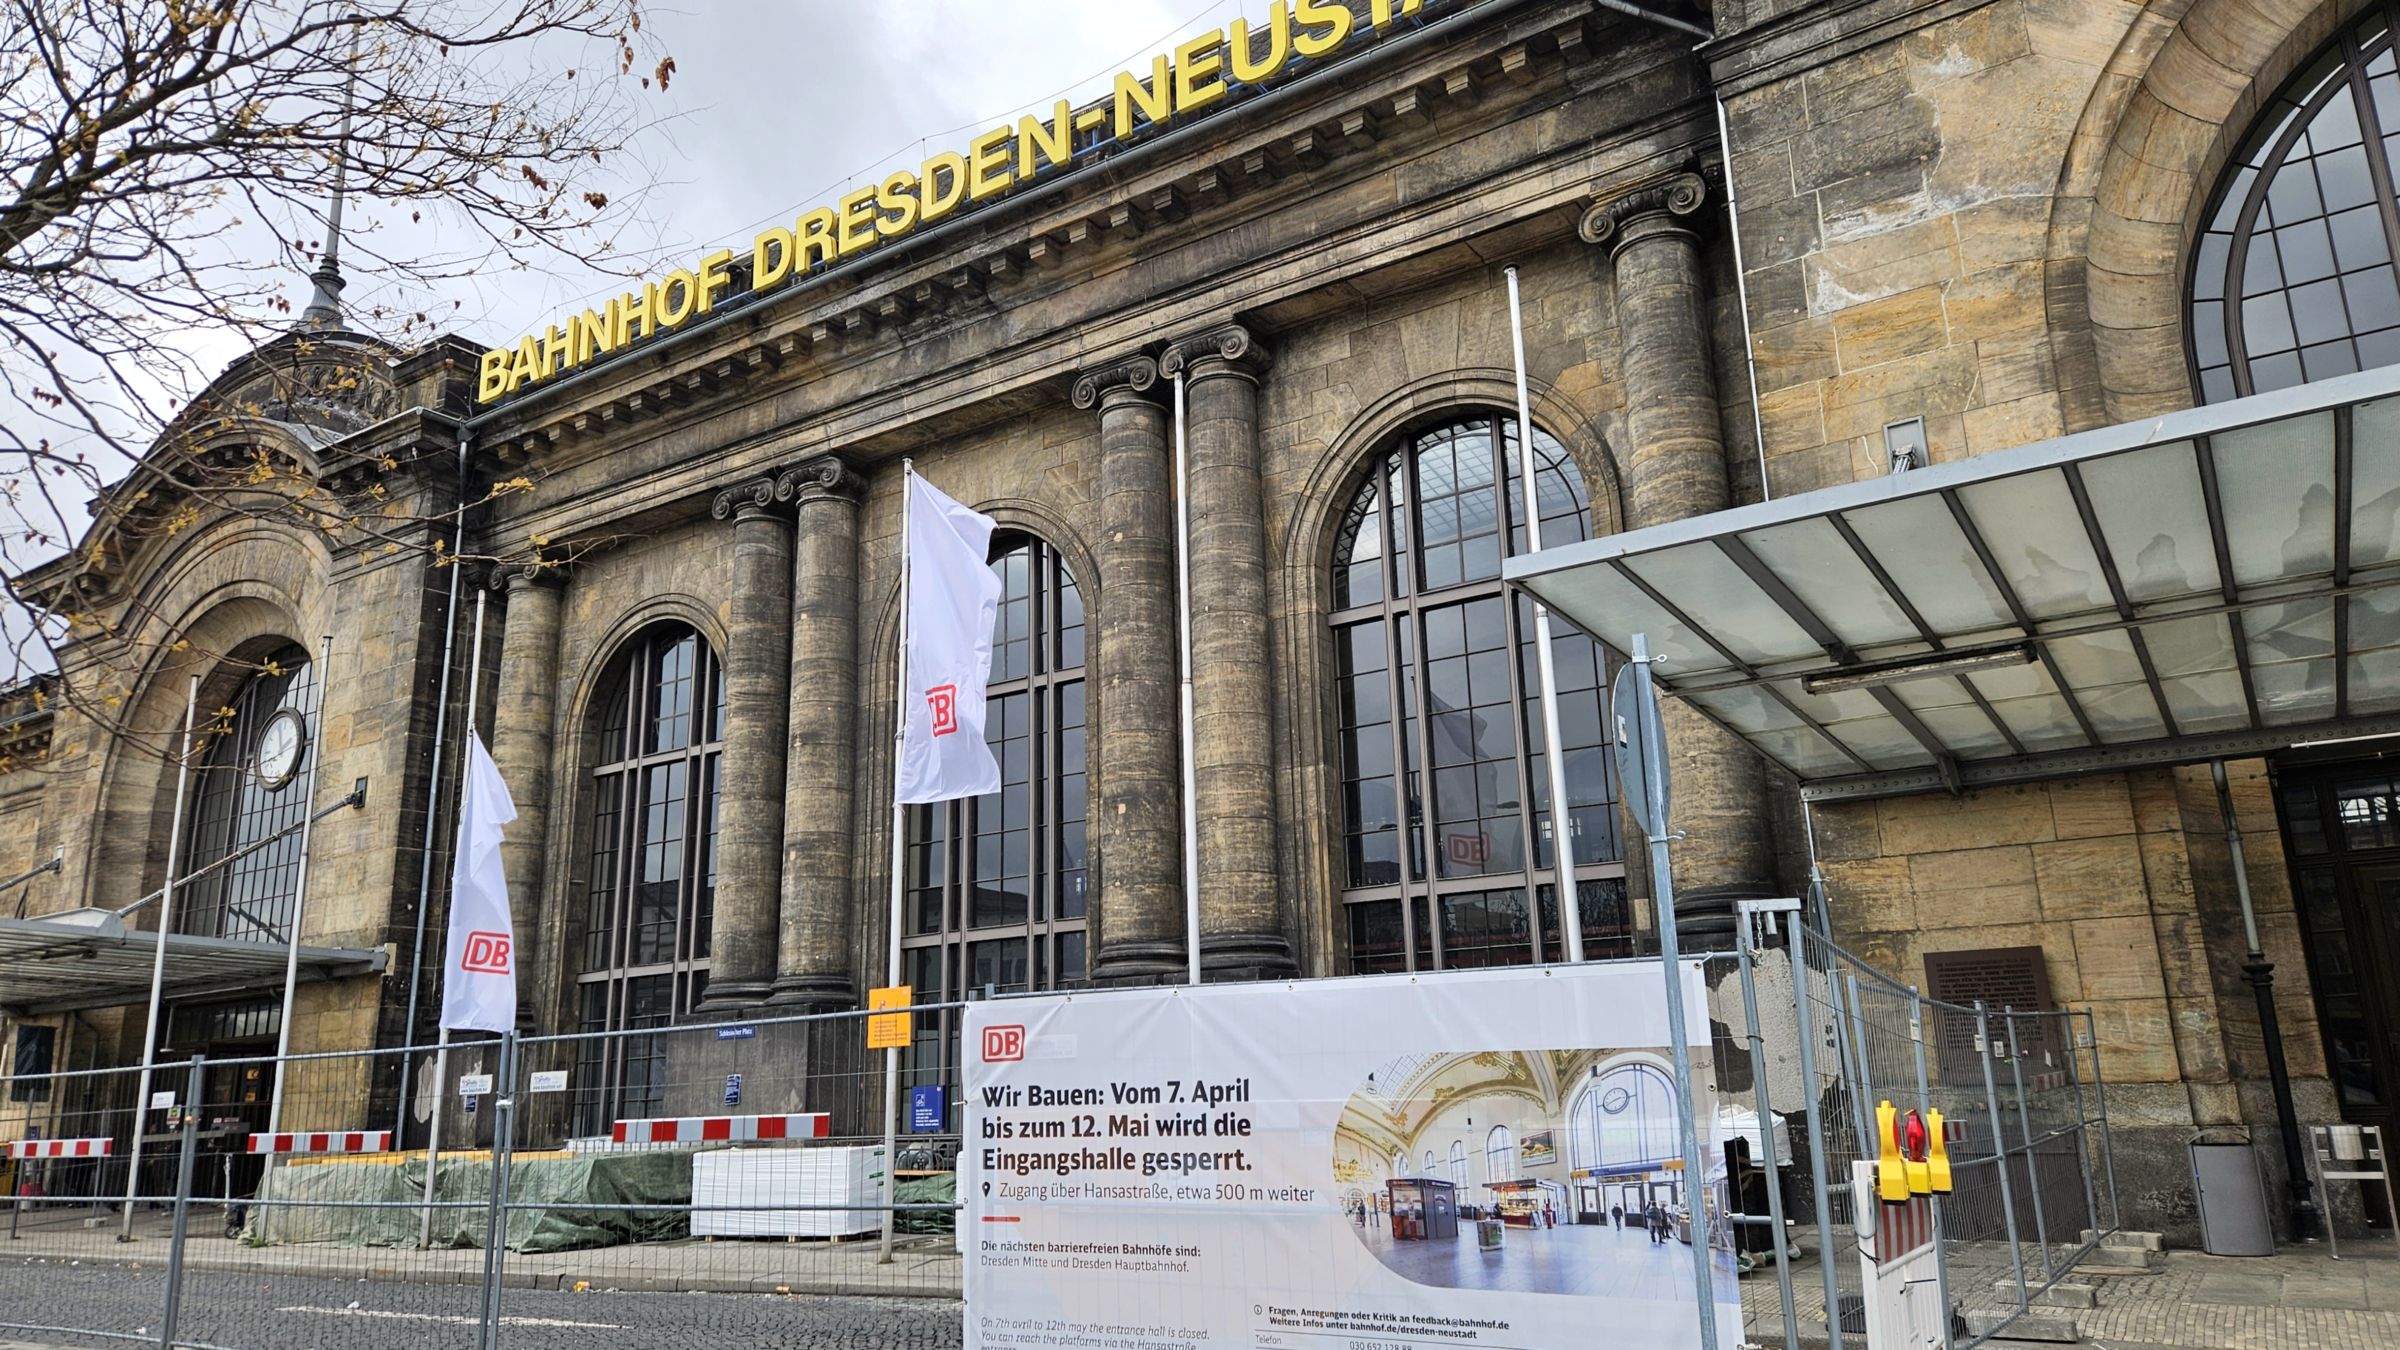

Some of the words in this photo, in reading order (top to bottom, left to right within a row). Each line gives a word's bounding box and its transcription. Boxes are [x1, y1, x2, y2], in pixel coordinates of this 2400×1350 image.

[478, 249, 733, 404] BAHNHOF
[753, 0, 1425, 293] DRESDEN-NEUS
[467, 936, 511, 969] DB
[984, 1029, 1022, 1059] DB
[982, 1084, 1022, 1107] Wir
[1028, 1083, 1105, 1106] Bauen:
[1110, 1081, 1161, 1105] Vom
[1166, 1081, 1185, 1104] 7.
[1191, 1078, 1250, 1109] April
[982, 1117, 1013, 1139] bis
[1019, 1119, 1066, 1138] zum
[1071, 1115, 1102, 1137] 12.
[1109, 1114, 1150, 1137] Mai
[1155, 1112, 1208, 1136] wird
[1213, 1111, 1252, 1136] die
[982, 1148, 1137, 1176] Eingangshalle
[1142, 1149, 1252, 1176] gesperrt.
[999, 1182, 1048, 1200] Zugang
[1050, 1182, 1081, 1198] über
[1084, 1182, 1173, 1200] Hansastraße,
[1176, 1186, 1212, 1200] etwa
[1215, 1184, 1245, 1201] 500
[1249, 1188, 1263, 1201] m
[1268, 1186, 1315, 1201] weiter
[981, 1240, 998, 1251] Die
[1000, 1241, 1045, 1253] nächsten
[1048, 1241, 1119, 1255] barrierefreien
[1122, 1243, 1172, 1257] Bahnhöfe
[1175, 1245, 1201, 1257] sind:
[981, 1255, 1020, 1268] Dresden
[1023, 1256, 1048, 1268] Mitte
[1050, 1257, 1069, 1269] und
[1072, 1258, 1112, 1270] Dresden
[1115, 1259, 1190, 1273] Hauptbahnhof.
[981, 1317, 993, 1328] On
[995, 1318, 1010, 1329] 7th
[1034, 1320, 1043, 1330] to
[1045, 1320, 1066, 1331] 12th
[1068, 1324, 1087, 1335] may
[1089, 1323, 1104, 1334] the
[1106, 1326, 1146, 1336] entrance
[1148, 1325, 1166, 1337] hall
[1167, 1326, 1175, 1338] is
[1178, 1328, 1211, 1340] closed.
[1268, 1306, 1298, 1317] Fragen,
[1301, 1307, 1349, 1321] Anregungen
[1351, 1311, 1371, 1321] oder
[1373, 1312, 1397, 1323] Kritik
[1412, 1314, 1510, 1330] feedback@bahnhof.de
[1269, 1317, 1301, 1328] Weitere
[1303, 1319, 1324, 1329] Infos
[1325, 1321, 1349, 1331] unter
[981, 1331, 997, 1342] You
[998, 1333, 1014, 1343] can
[1016, 1333, 1041, 1344] reach
[1043, 1334, 1057, 1345] the
[1059, 1335, 1101, 1349] platforms
[1104, 1337, 1118, 1348] via
[1120, 1338, 1135, 1349] the
[1255, 1335, 1282, 1345] Telefon
